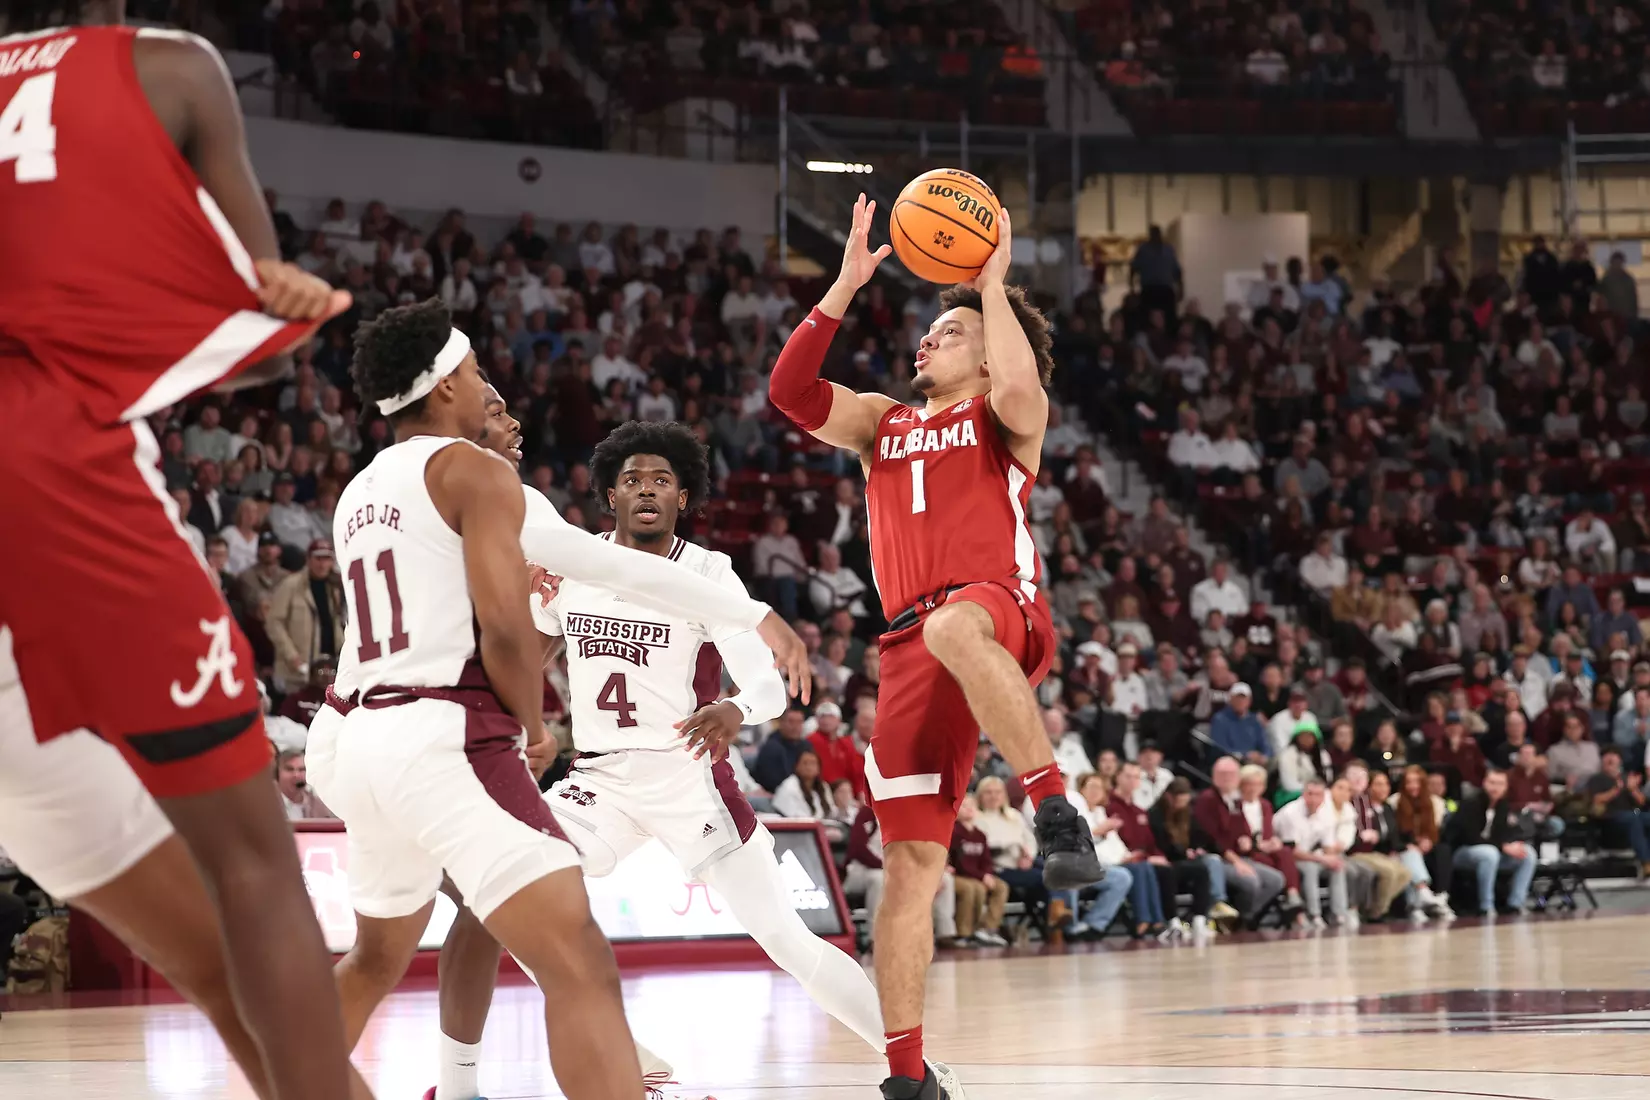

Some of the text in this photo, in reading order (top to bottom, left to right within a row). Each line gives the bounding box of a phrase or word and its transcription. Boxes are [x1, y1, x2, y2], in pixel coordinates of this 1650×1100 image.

[927, 183, 994, 232] Wilson
[880, 419, 978, 462] ALABAMA
[911, 459, 926, 515] 1
[379, 504, 404, 533] JR.
[347, 548, 410, 663] 11
[566, 615, 671, 644] MISSISSIPPI
[170, 614, 245, 708] A
[587, 641, 636, 662] STATE
[596, 672, 638, 729] 4
